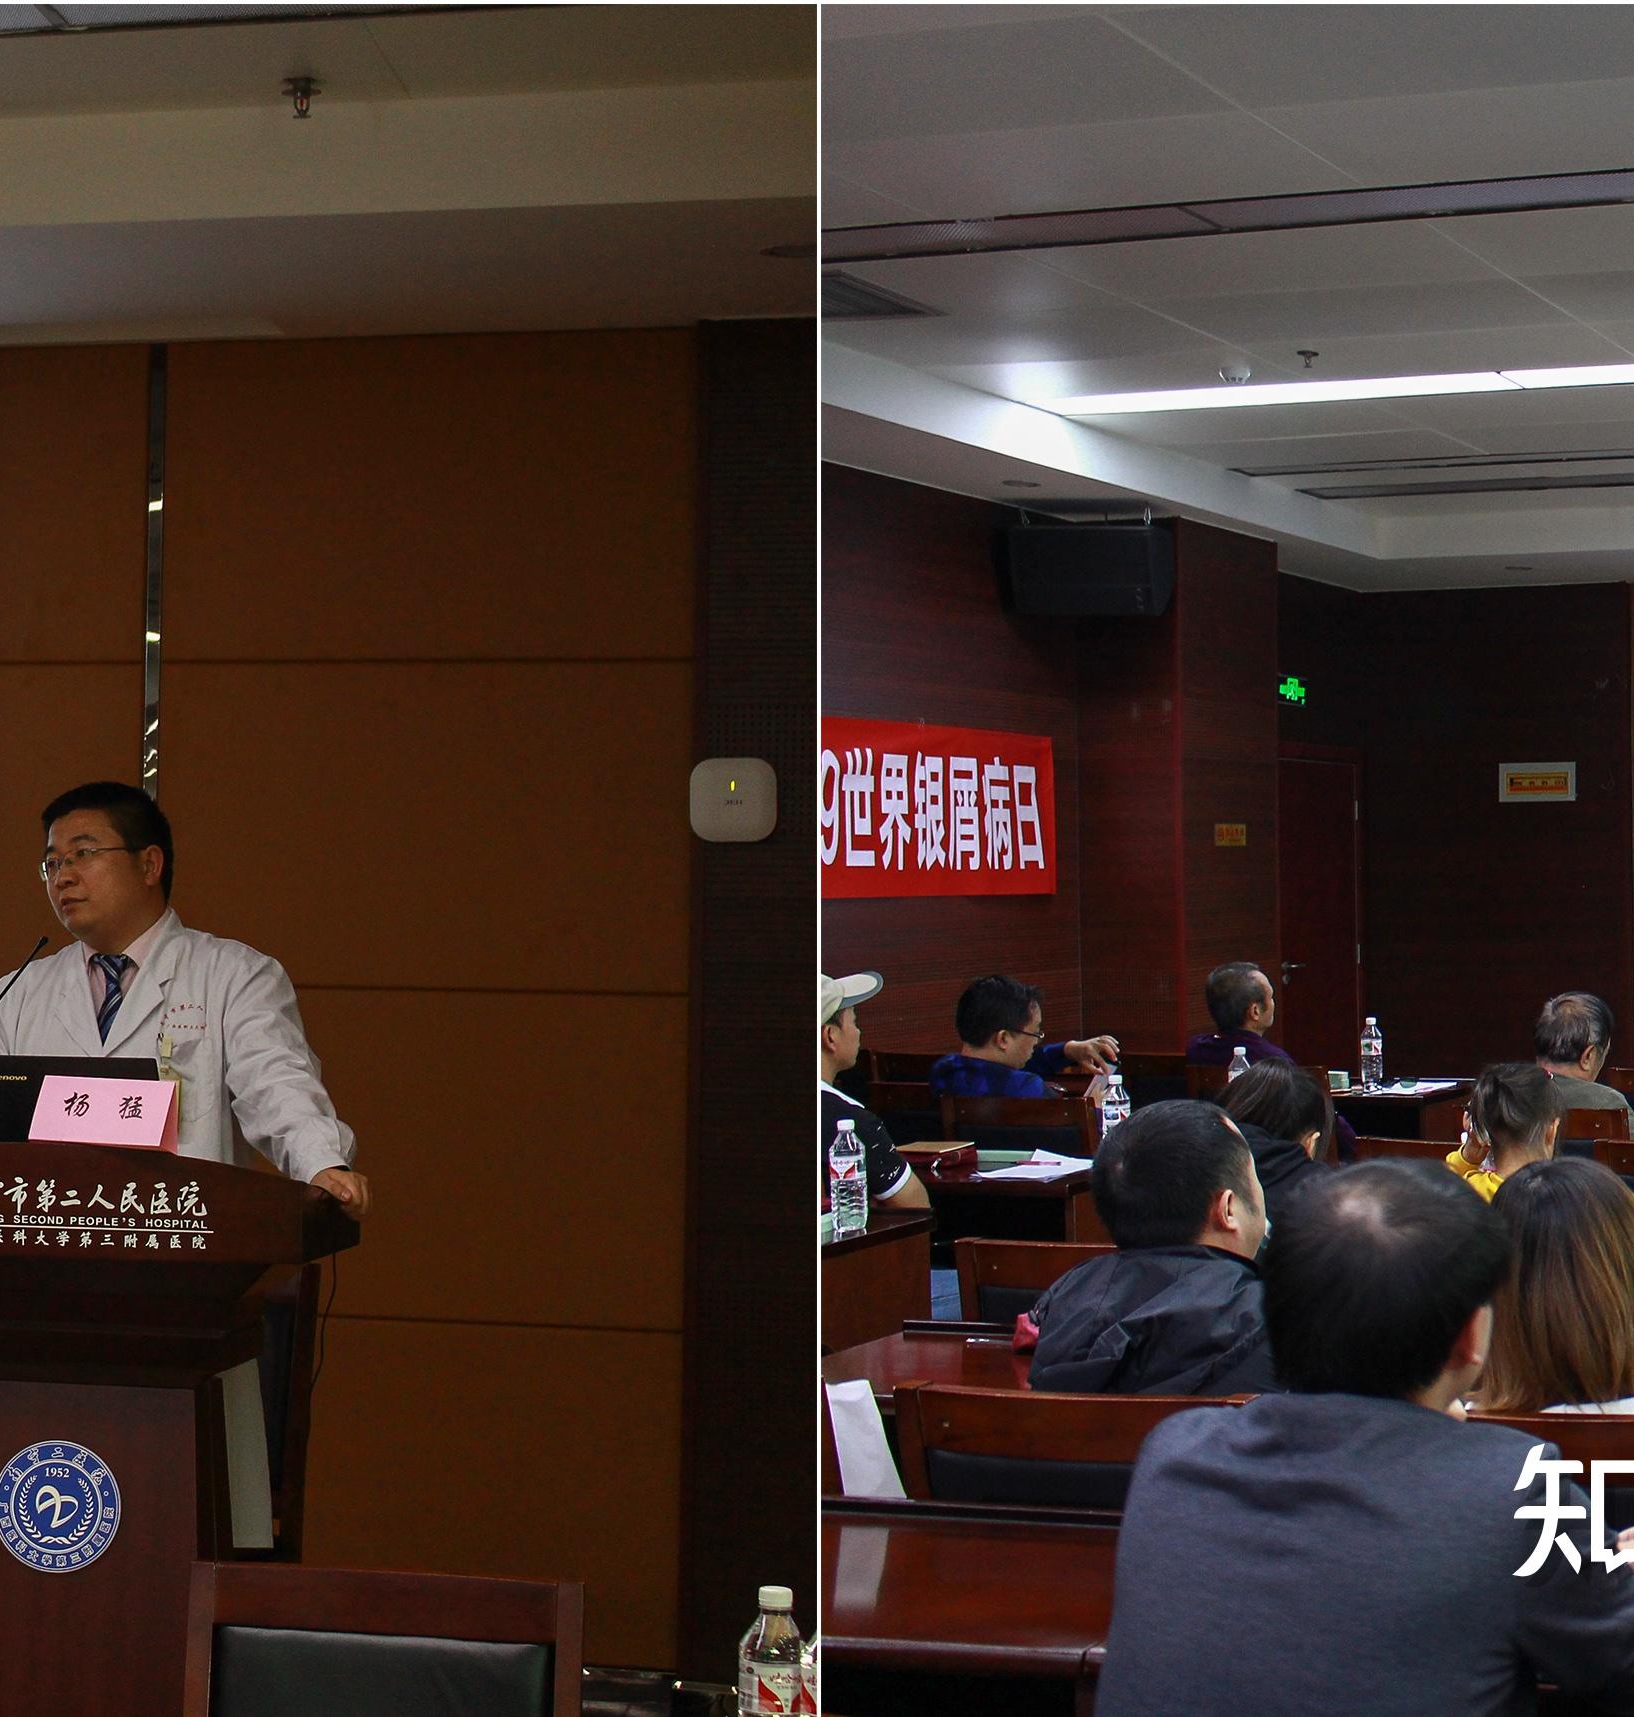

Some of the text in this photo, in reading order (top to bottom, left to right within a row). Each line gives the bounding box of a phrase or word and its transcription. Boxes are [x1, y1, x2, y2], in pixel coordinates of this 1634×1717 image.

[821, 748, 1045, 871] 9世界银屑病日
[13, 1215, 64, 1225] SECOND
[145, 1218, 208, 1229] HOSPITAL
[45, 1467, 70, 1478] 1952
